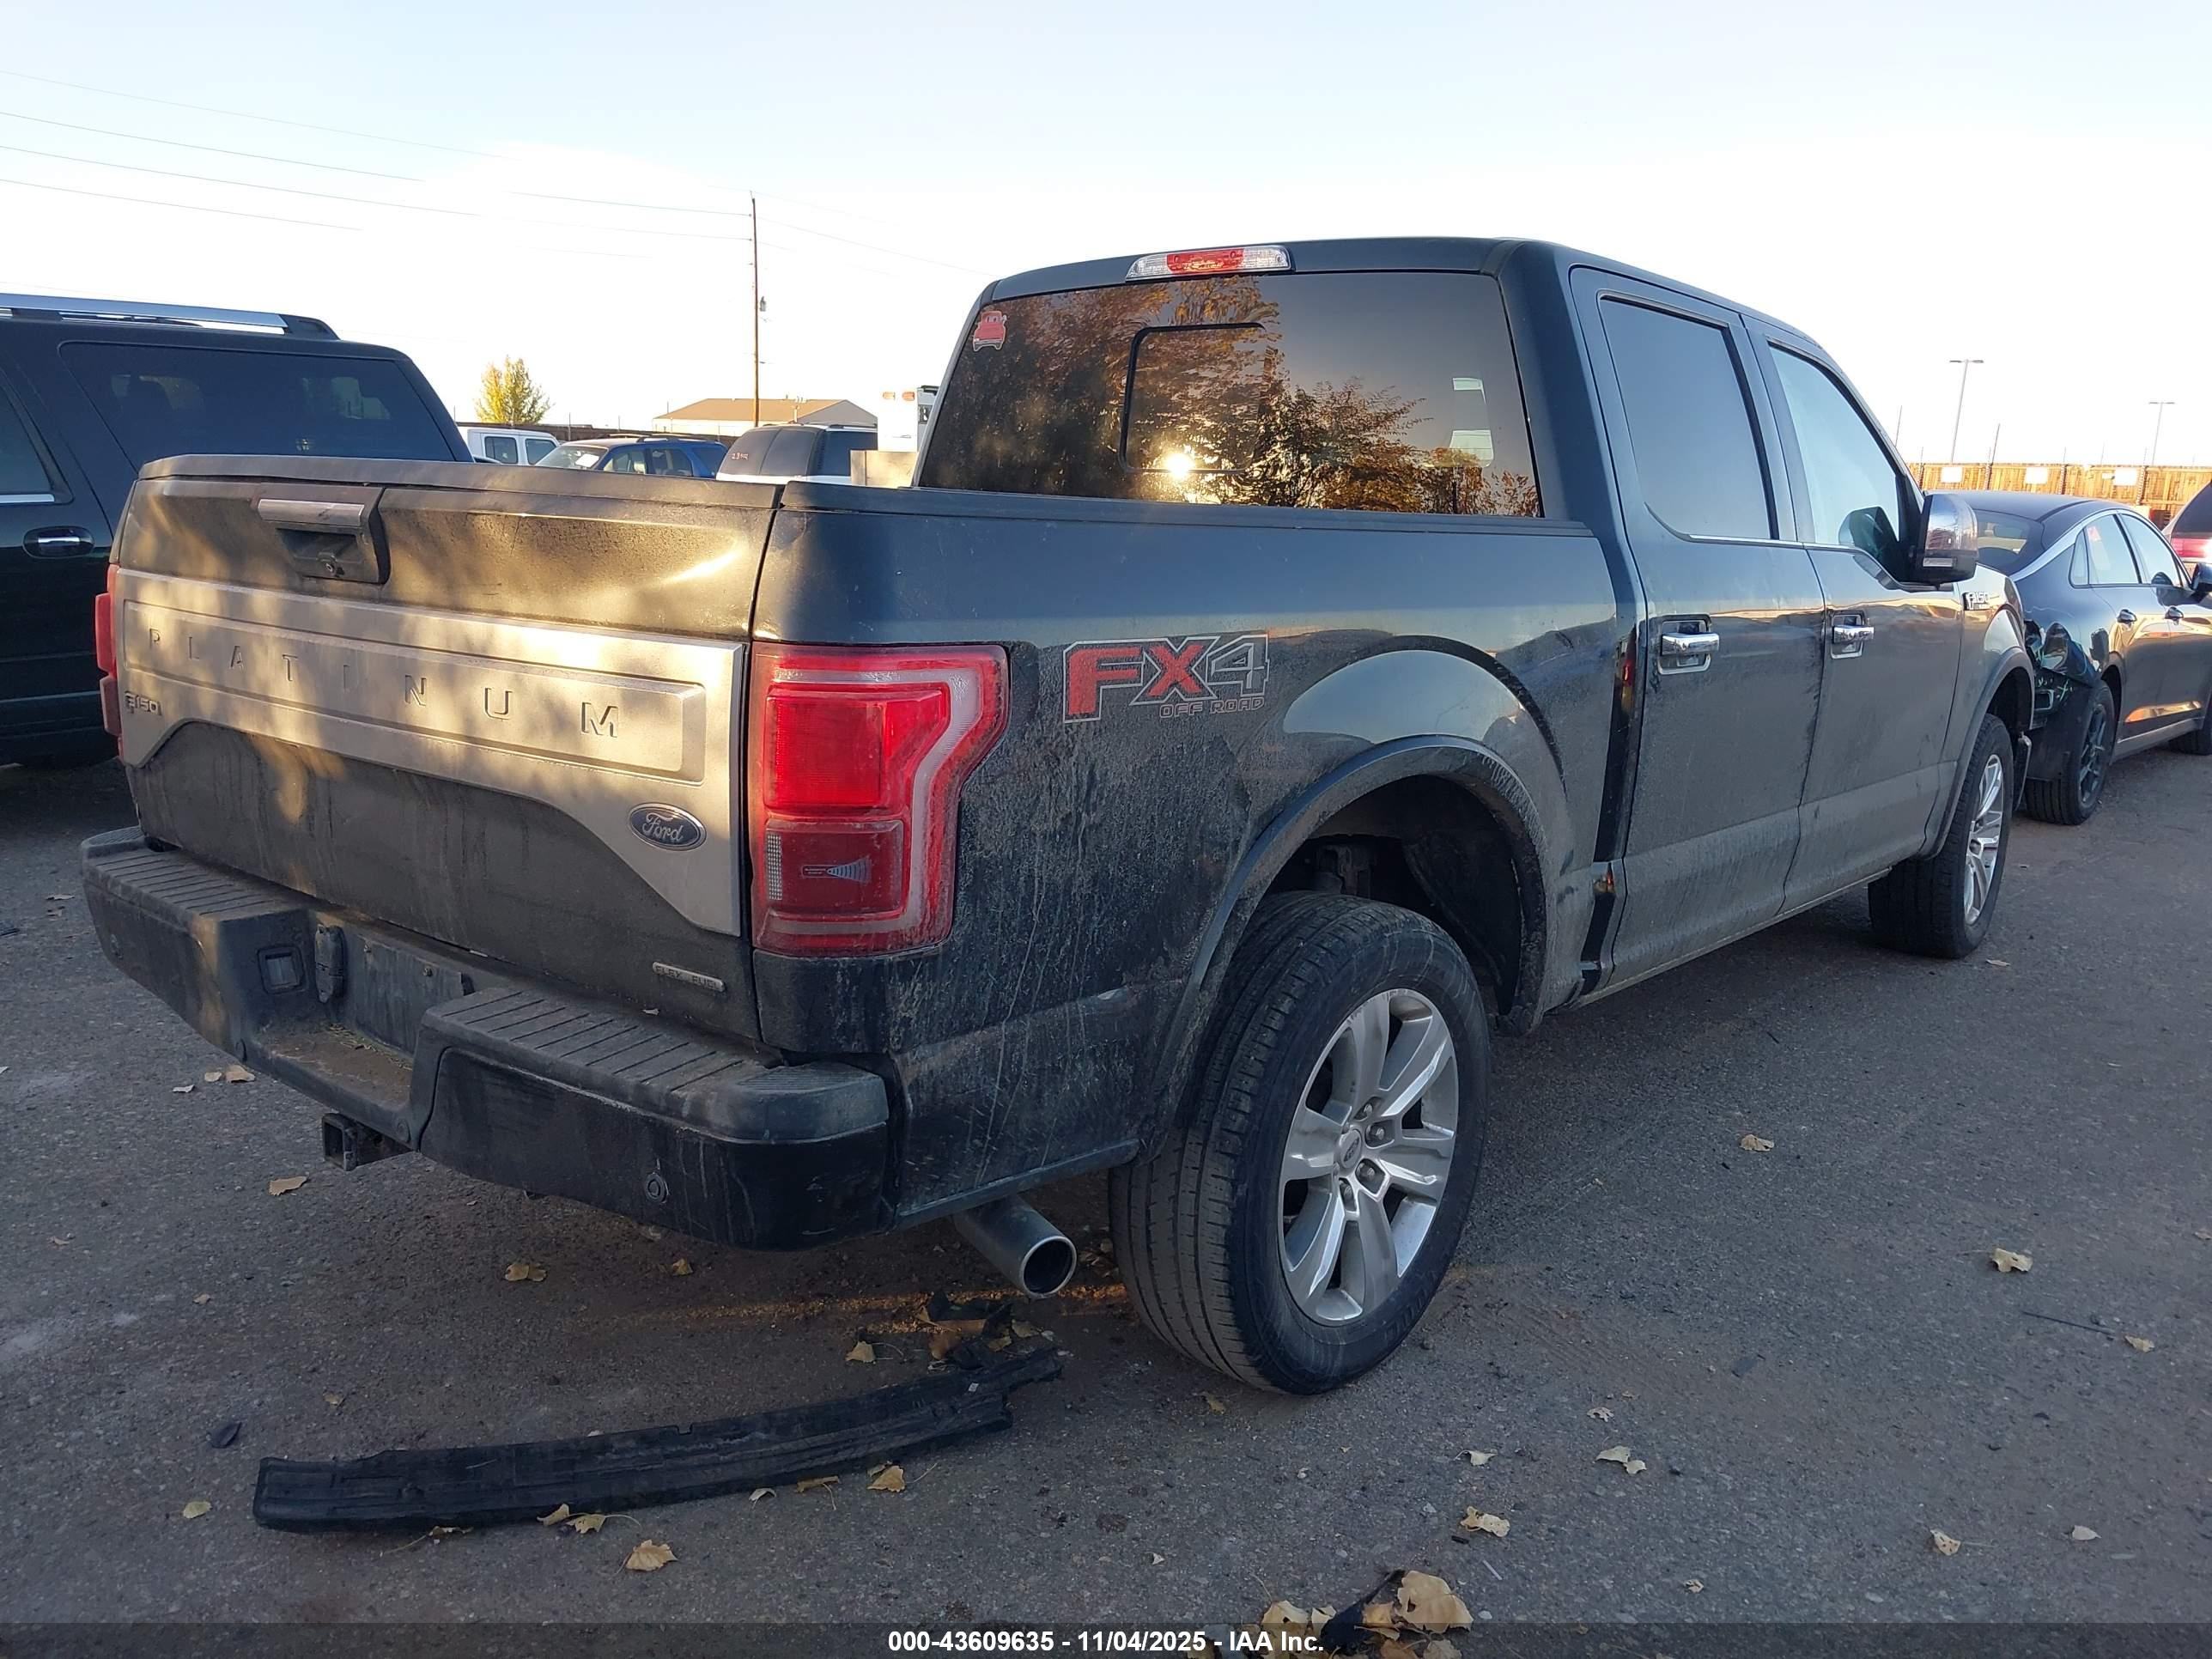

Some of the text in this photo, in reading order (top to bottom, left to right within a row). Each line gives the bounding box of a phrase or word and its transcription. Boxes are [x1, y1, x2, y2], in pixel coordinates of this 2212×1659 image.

[149, 628, 619, 739] PLATINUM
[1063, 635, 1270, 723] FX4
[1160, 696, 1265, 719] OFF ROAD
[641, 811, 684, 842] Ford
